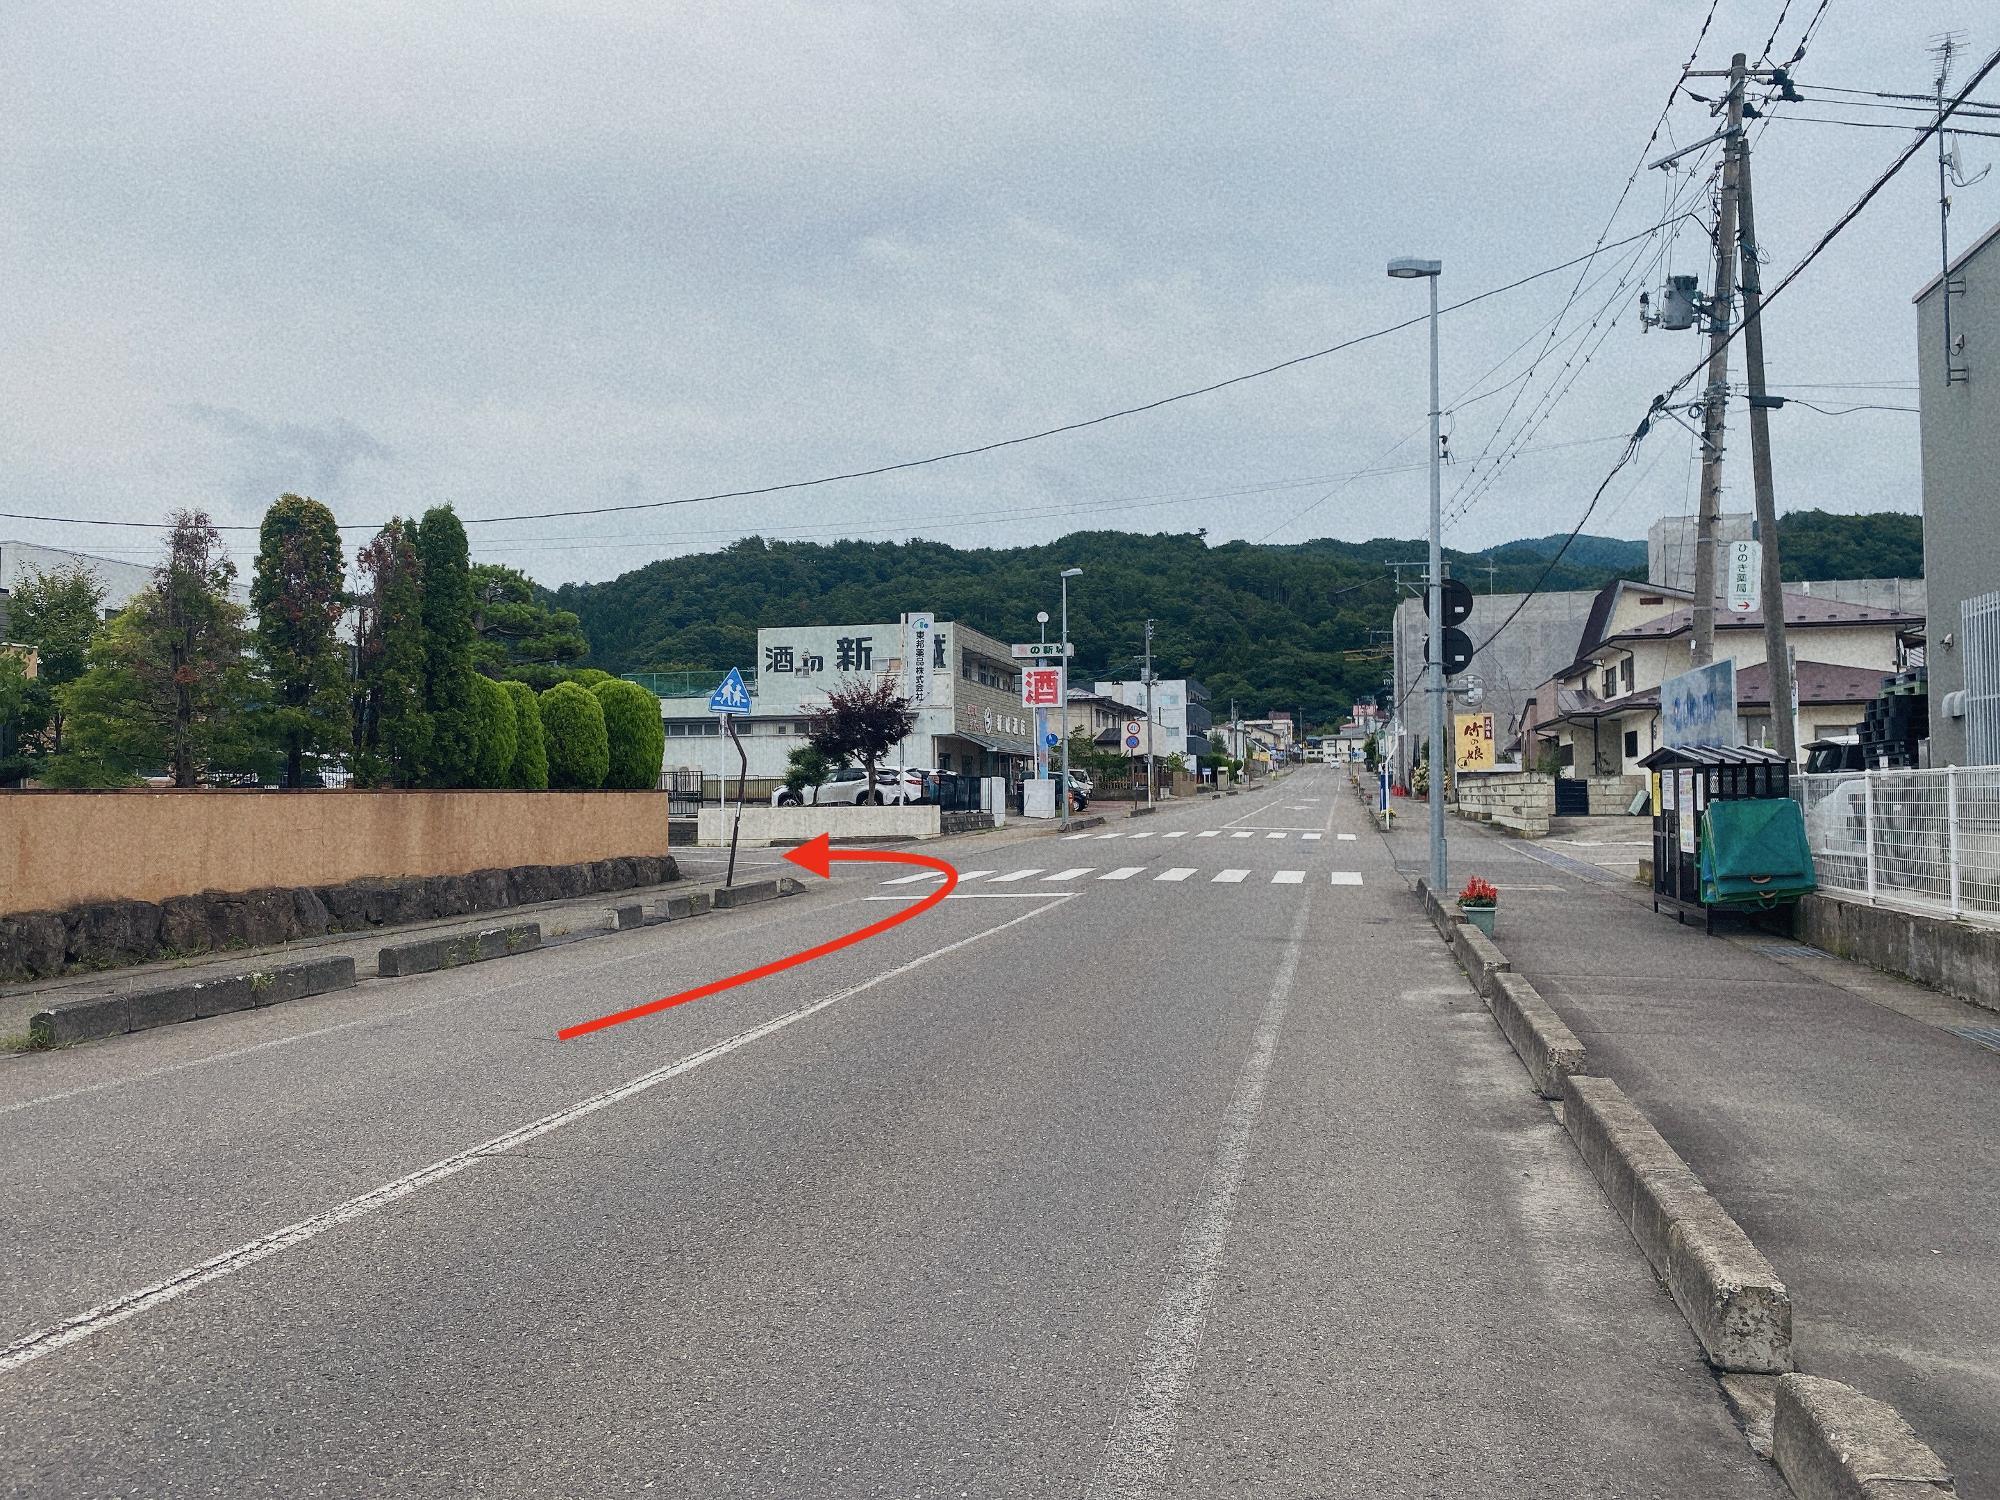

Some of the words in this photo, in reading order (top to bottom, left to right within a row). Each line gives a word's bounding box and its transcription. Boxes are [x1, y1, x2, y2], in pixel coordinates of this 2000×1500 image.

[1736, 543, 1748, 593] ひのき薬局
[915, 630, 925, 703] 東邦薬品株式会社
[1025, 670, 1059, 705] 酒
[1464, 721, 1484, 760] 竹の娘
